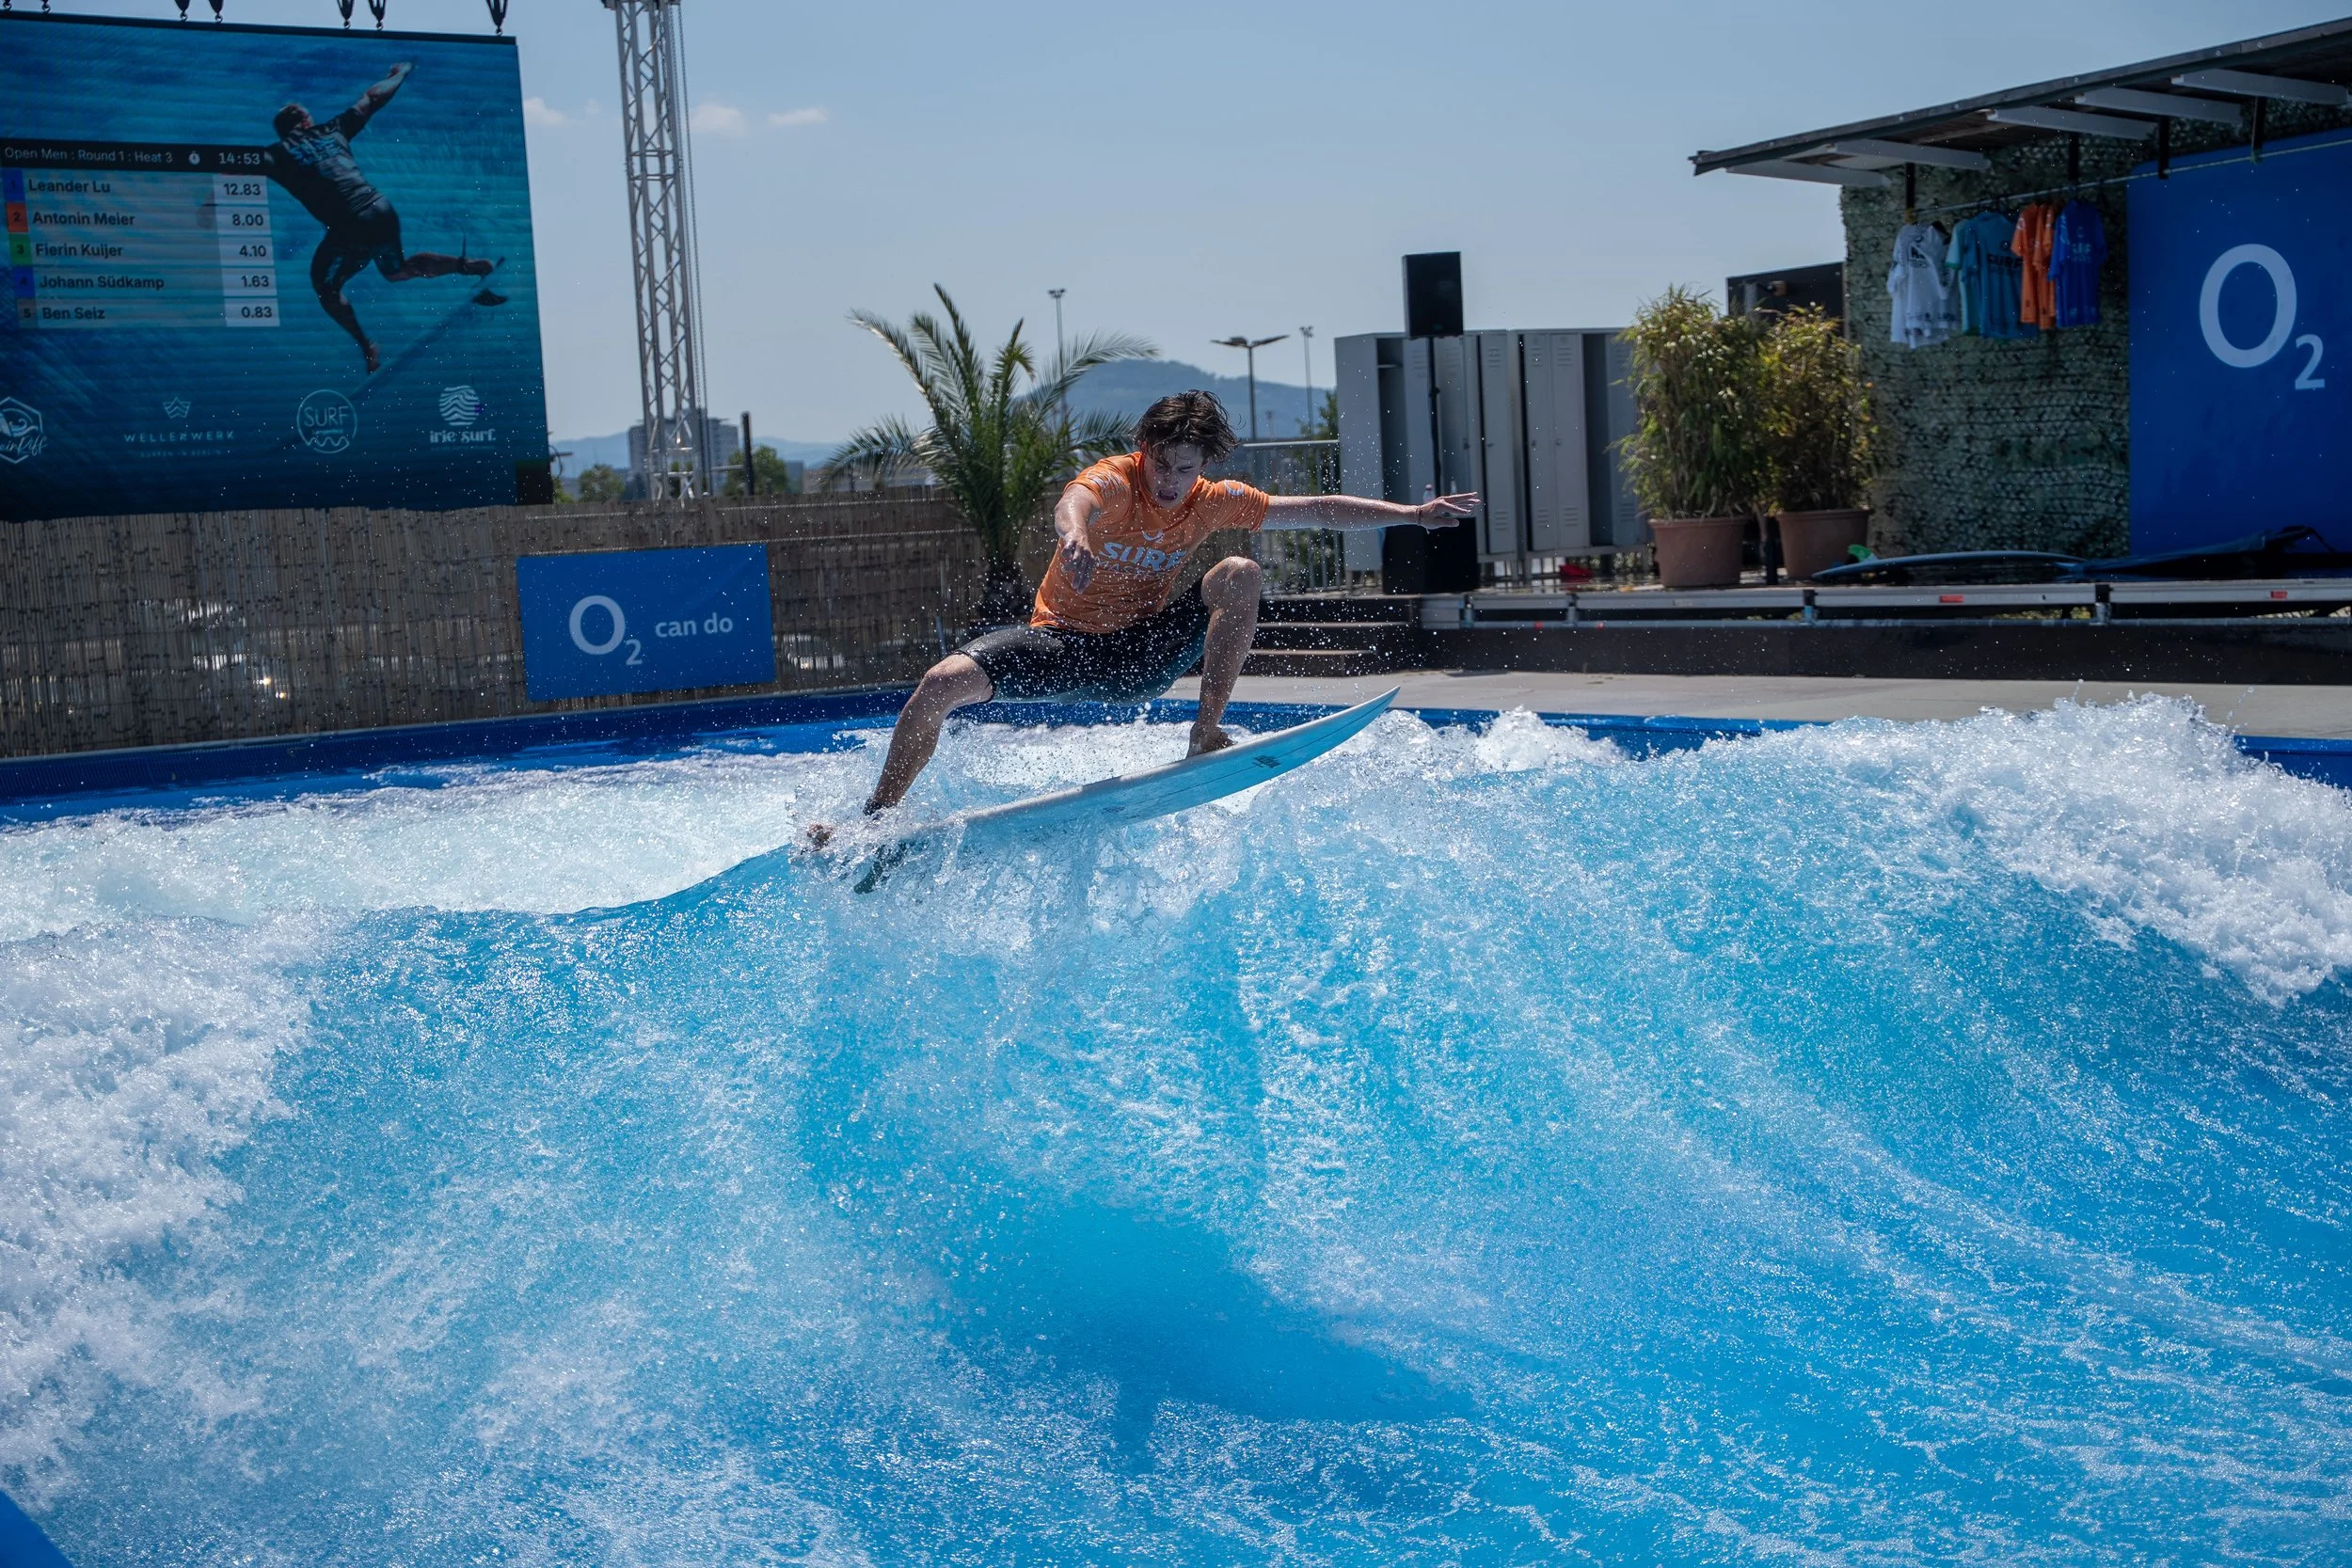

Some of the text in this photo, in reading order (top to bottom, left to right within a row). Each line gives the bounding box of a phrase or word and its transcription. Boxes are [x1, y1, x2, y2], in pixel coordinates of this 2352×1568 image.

[5, 147, 38, 159] Open
[40, 149, 68, 160] Men
[78, 150, 117, 161] Round
[119, 150, 124, 161] 1
[135, 151, 162, 163] Heat
[165, 152, 173, 164] 3
[218, 153, 261, 165] 14:53
[28, 179, 89, 193] Leander
[92, 181, 111, 193] Lu
[224, 183, 262, 196] 12.83
[13, 212, 135, 226] 2 Antonin Meier
[231, 214, 263, 226] 8.00
[17, 244, 24, 254] 3
[81, 244, 123, 259] Kuijer
[239, 245, 266, 257] 4.10
[40, 277, 94, 289] Johann
[97, 276, 165, 291] Südkamp
[241, 276, 269, 287] 1.63
[24, 308, 105, 320] 5 Ben Seiz
[241, 307, 273, 318] 0.83
[304, 406, 349, 427] SURF
[429, 430, 456, 443] irie
[1098, 542, 1188, 572] SURF
[655, 620, 697, 638] can
[703, 612, 734, 634] do
